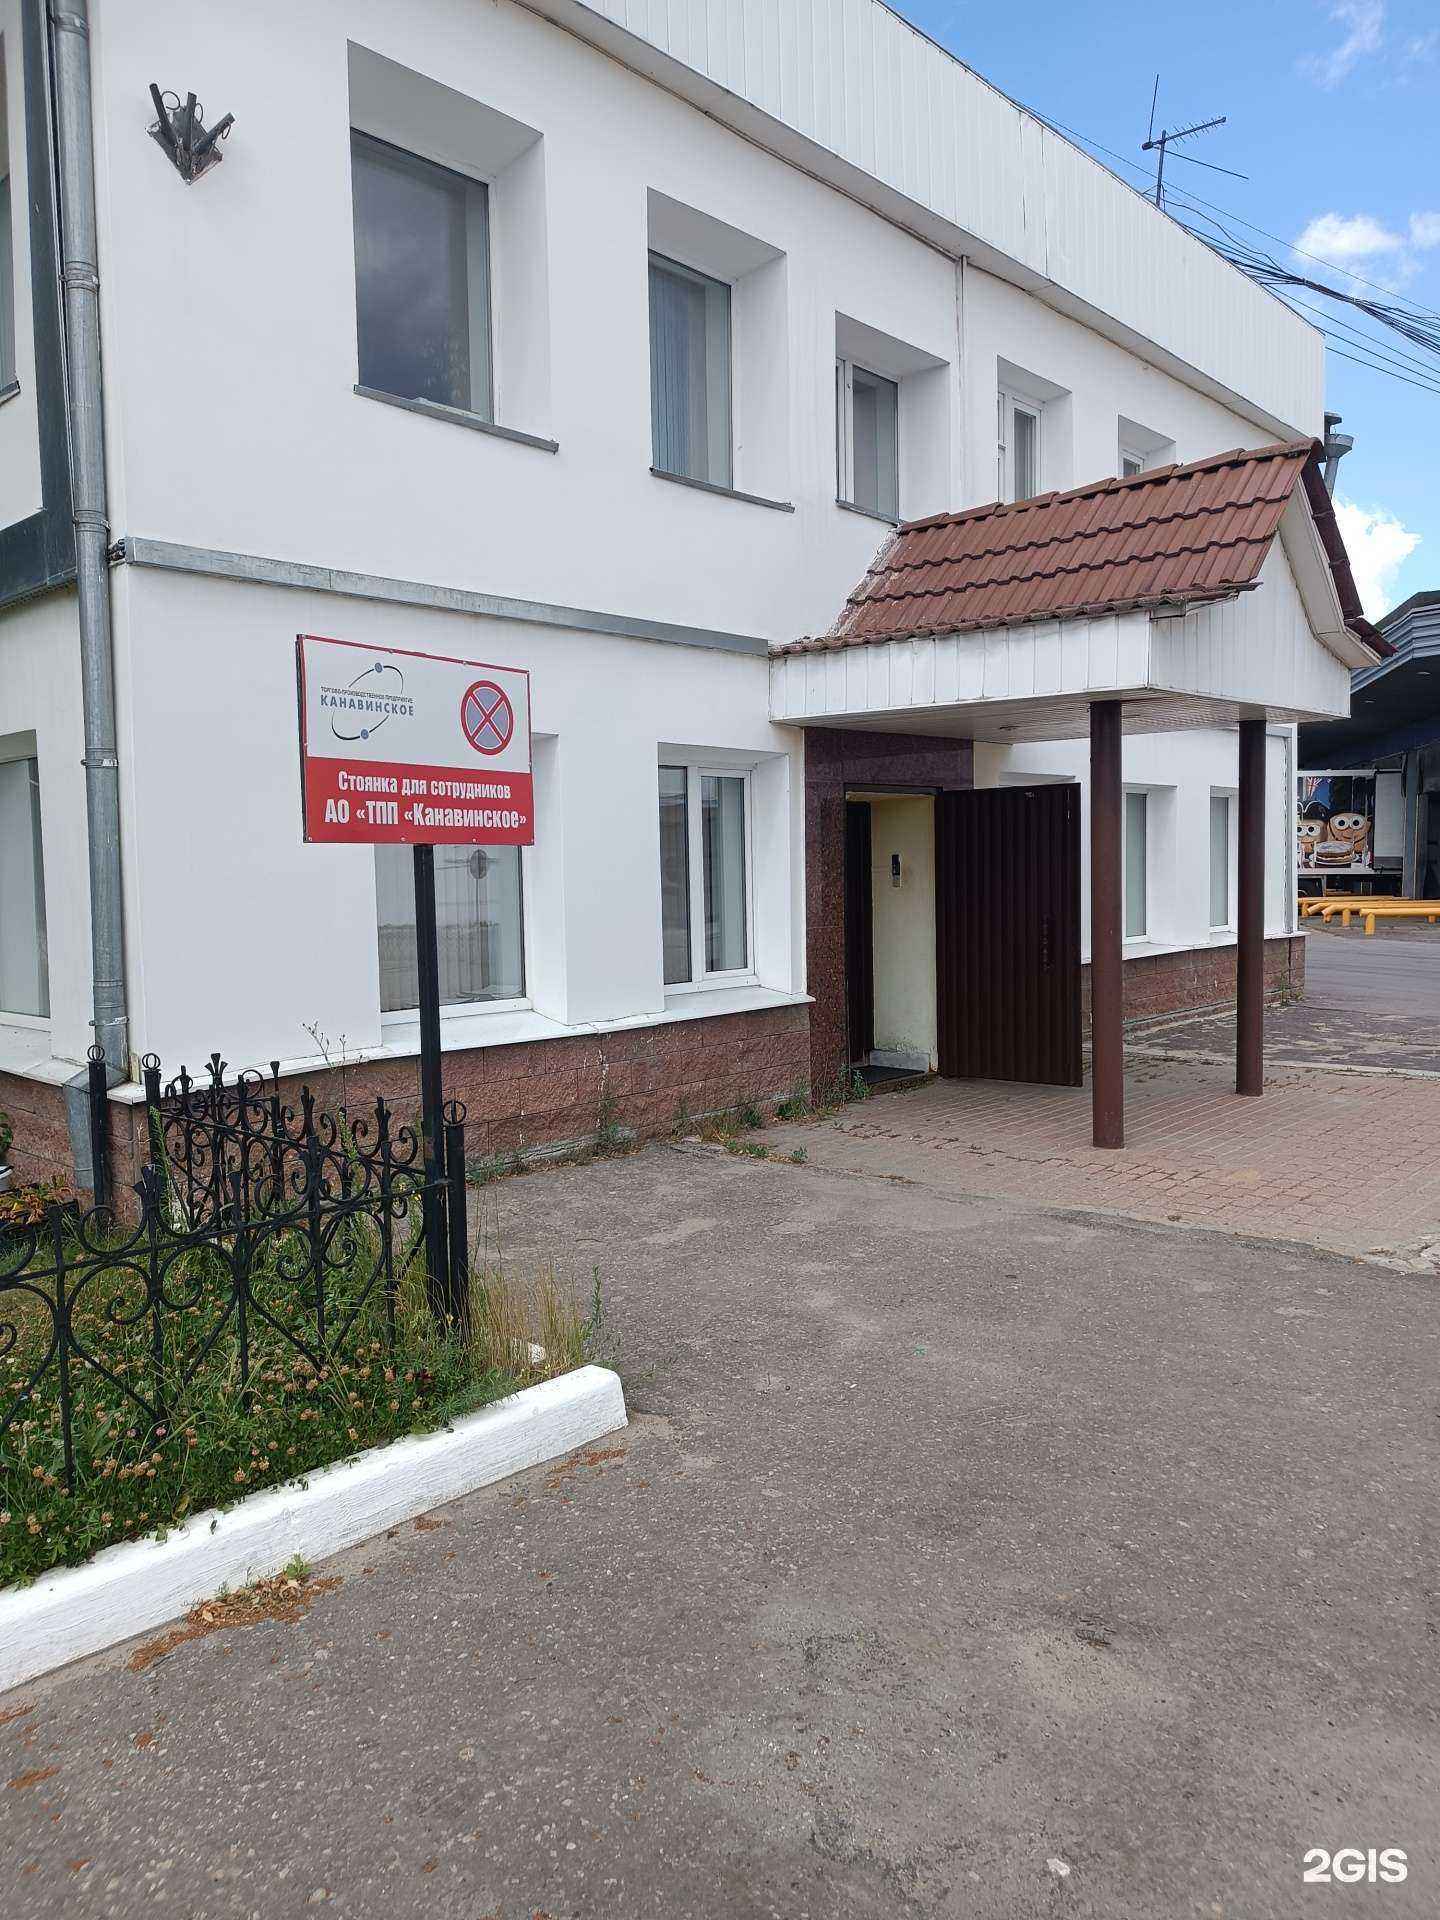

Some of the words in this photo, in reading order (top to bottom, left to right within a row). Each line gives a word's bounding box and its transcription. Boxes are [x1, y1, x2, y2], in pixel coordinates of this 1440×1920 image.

[320, 694, 414, 716] КАНАВИНСКОЕ
[338, 770, 398, 794] Стоянка
[401, 778, 427, 796] для
[430, 779, 511, 799] сотрудников
[324, 798, 350, 824] АО
[356, 799, 399, 825] «ТПП
[404, 802, 527, 829] «Канавинское»
